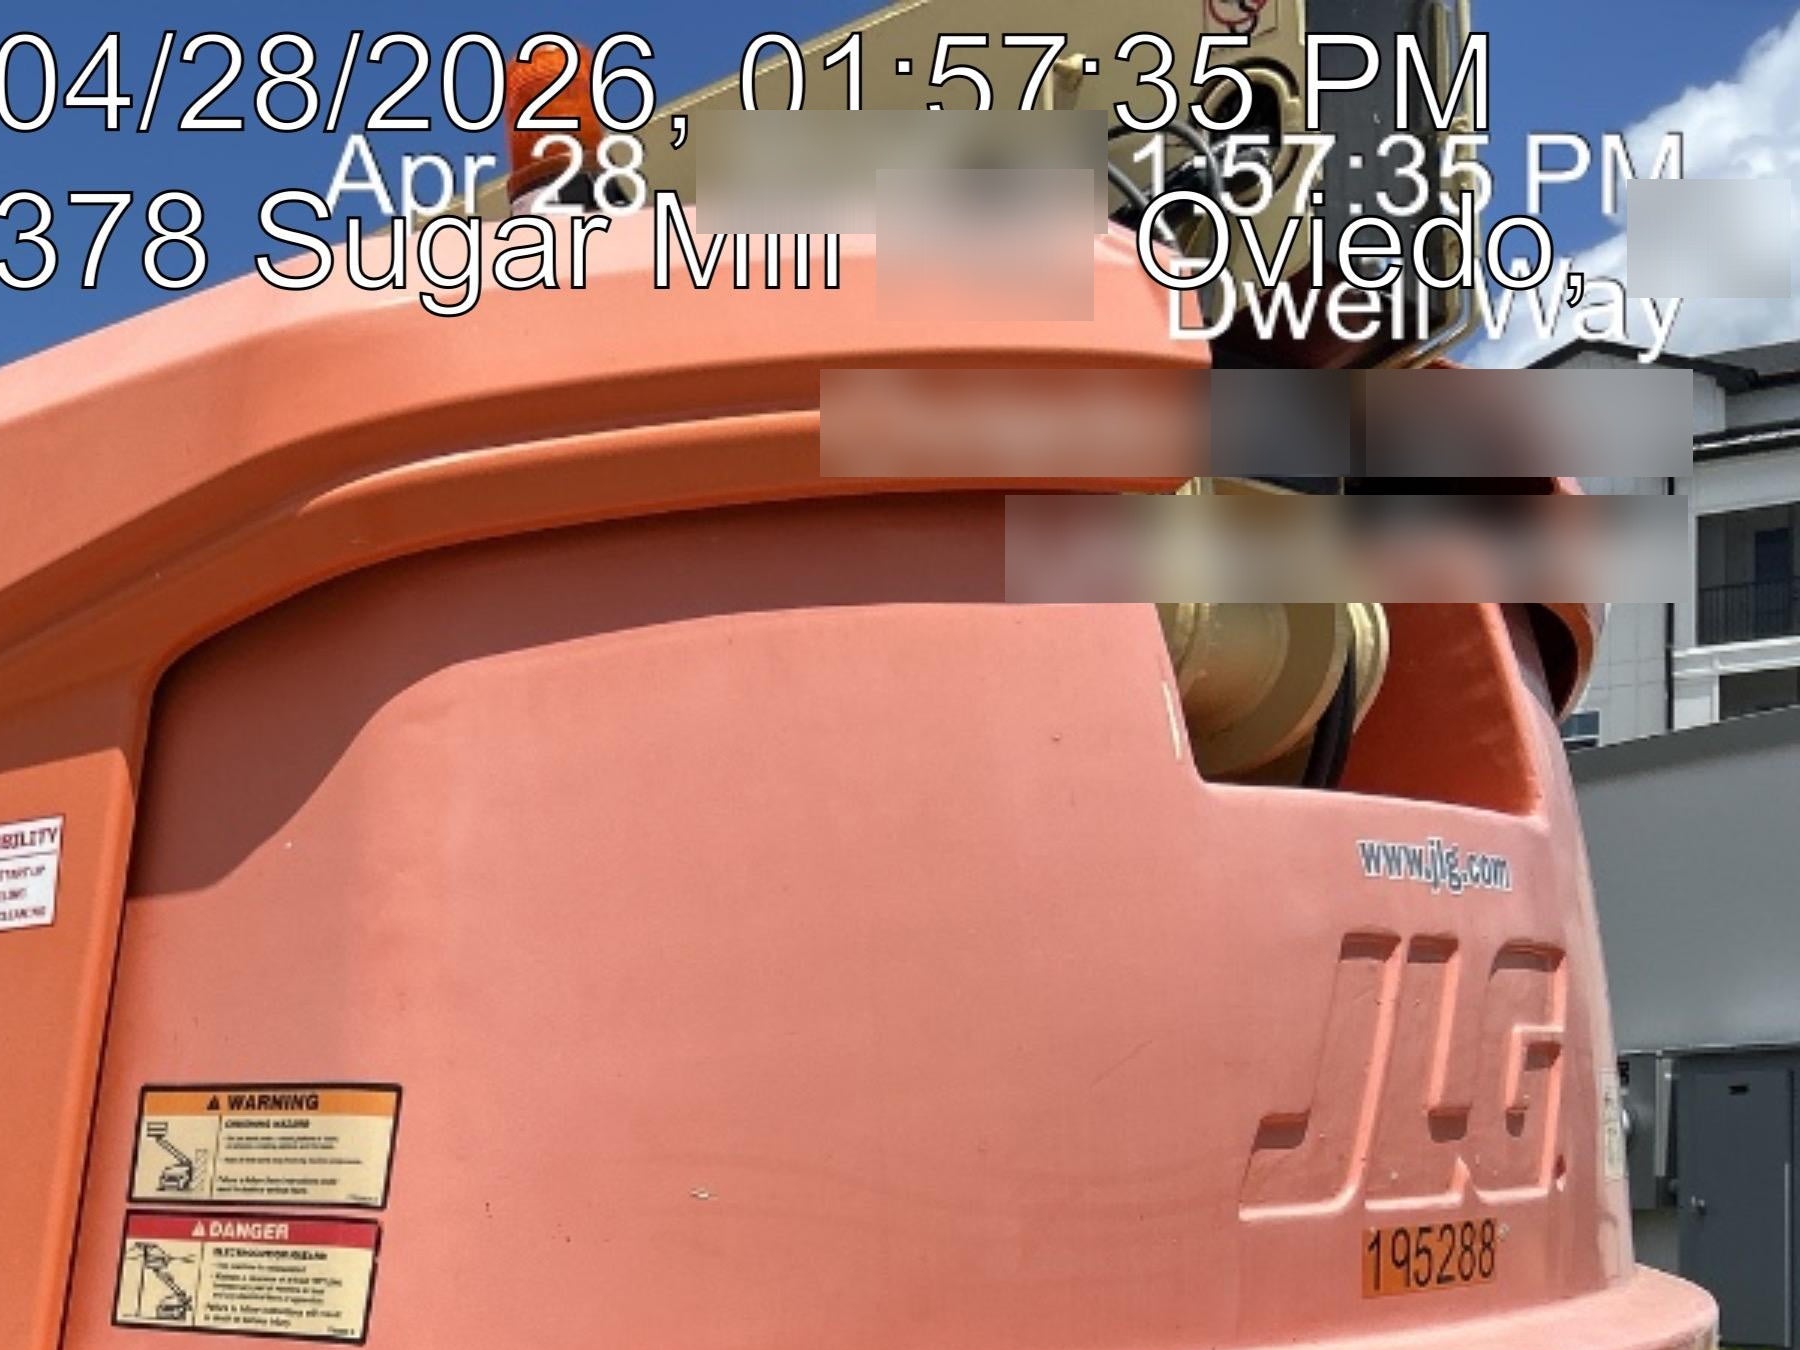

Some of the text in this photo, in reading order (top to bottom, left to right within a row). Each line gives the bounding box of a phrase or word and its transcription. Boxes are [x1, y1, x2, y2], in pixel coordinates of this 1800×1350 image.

[1357, 837, 1513, 894] www.jlg.com
[227, 1094, 320, 1111] WARNING
[209, 1223, 289, 1241] DANGER
[1365, 1217, 1496, 1290] 195288
